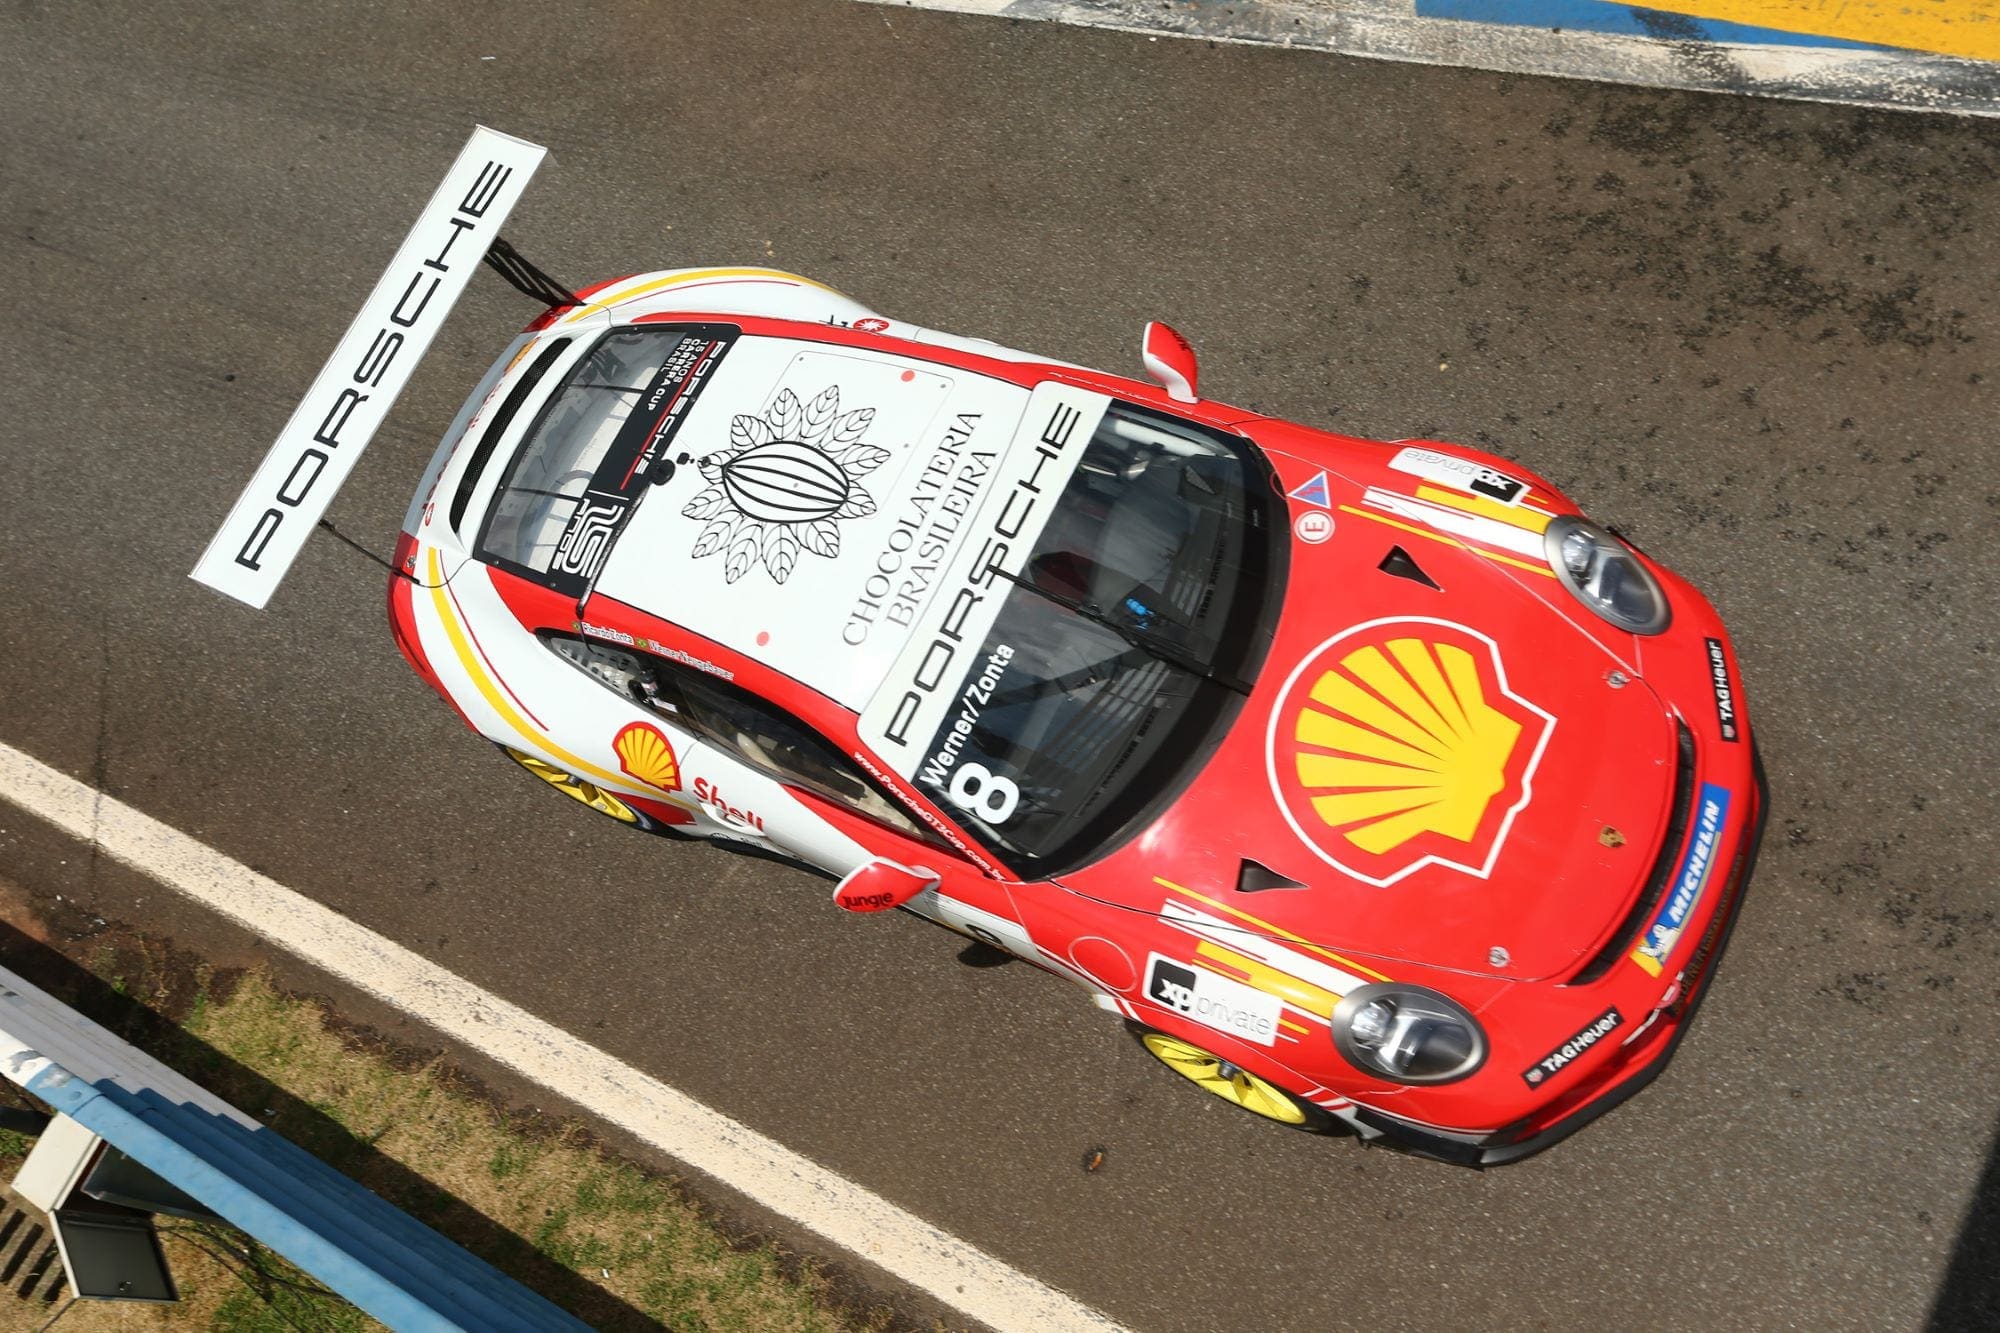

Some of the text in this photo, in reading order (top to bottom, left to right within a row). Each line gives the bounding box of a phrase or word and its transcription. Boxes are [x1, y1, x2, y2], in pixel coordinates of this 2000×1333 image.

[235, 160, 512, 572] PORSCHE
[647, 338, 701, 411] CARRERA CUP
[660, 338, 692, 372] BRASIL
[673, 340, 710, 384] 15 ANOS
[634, 340, 727, 475] PORSCHE
[842, 412, 984, 646] CHOCOLATERIA
[884, 402, 1082, 748] PORSCHE
[885, 450, 998, 629] BRASILEIRA
[920, 643, 1015, 787] Werner/Zonta
[693, 776, 765, 832] Shell
[949, 761, 1020, 825] 8
[842, 890, 894, 909] jungle
[1668, 799, 1721, 922] MICHELIN
[1194, 995, 1272, 1036] private
